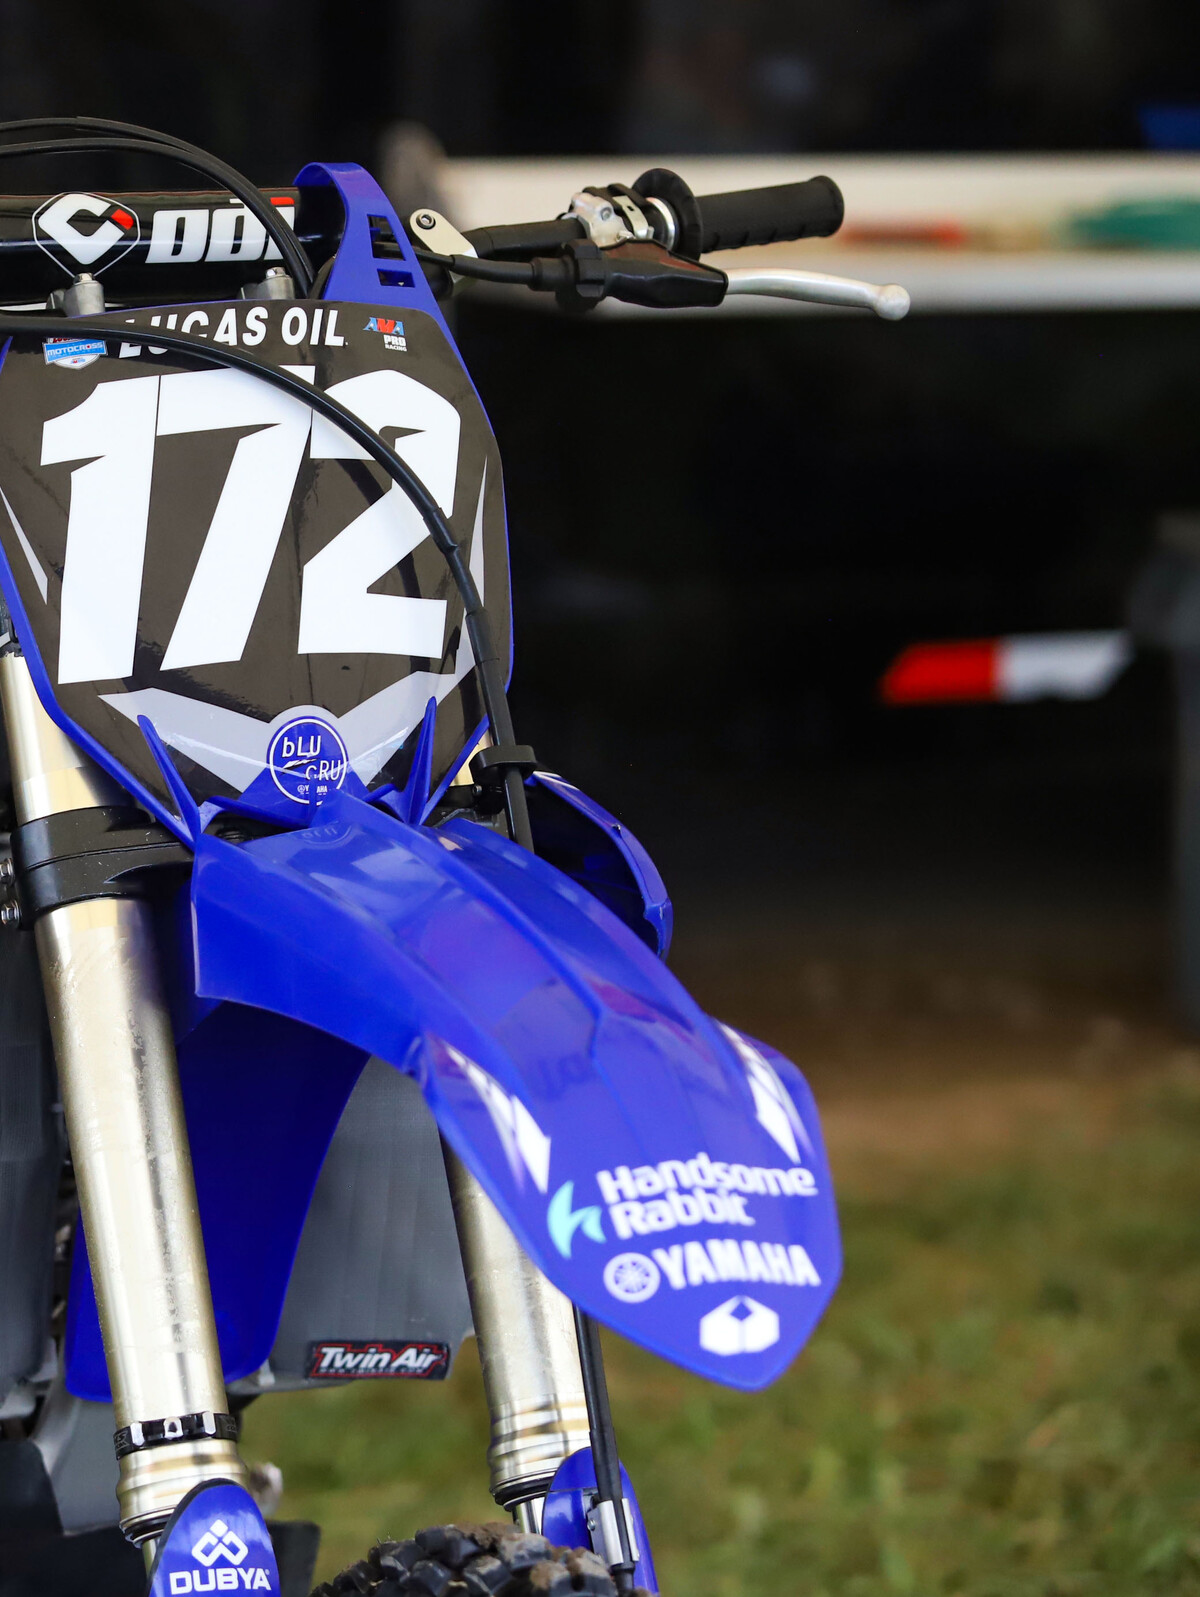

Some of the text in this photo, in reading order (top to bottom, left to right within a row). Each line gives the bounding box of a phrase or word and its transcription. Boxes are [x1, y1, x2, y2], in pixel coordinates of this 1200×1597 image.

[281, 307, 345, 346] OIL
[362, 316, 405, 336] AMA
[383, 334, 407, 347] PRO
[47, 341, 104, 356] MOTOCROSS
[40, 364, 461, 685] 172
[596, 1151, 819, 1205] Handsome
[608, 1186, 756, 1241] Rabbit
[651, 1238, 822, 1290] YAMAHA
[319, 1346, 442, 1369] Twin Air
[169, 1567, 272, 1595] DUBYA
